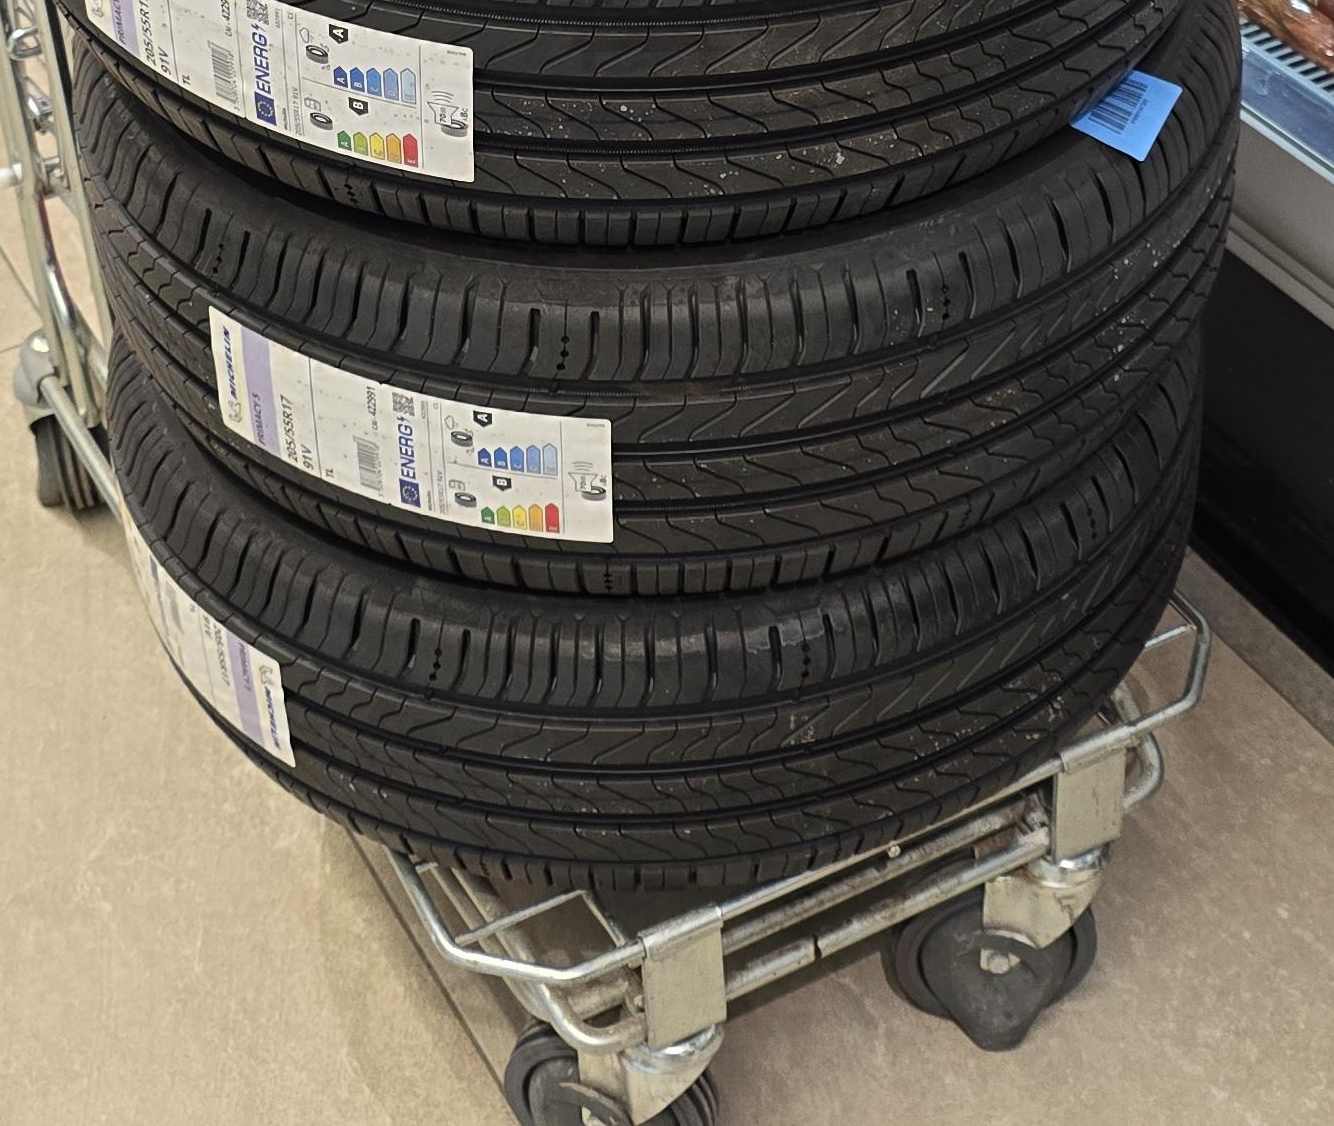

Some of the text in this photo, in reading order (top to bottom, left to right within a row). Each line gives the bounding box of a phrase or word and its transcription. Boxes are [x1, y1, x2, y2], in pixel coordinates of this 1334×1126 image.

[158, 47, 172, 75] 91V
[182, 74, 191, 86] TL
[252, 32, 271, 95] ENERG
[223, 326, 238, 400] MICHELIN
[366, 385, 377, 415] 422991
[280, 394, 298, 462] 205/55R17
[303, 444, 314, 470] 91V
[326, 468, 334, 478] TL
[398, 423, 417, 480] ENERG
[265, 686, 281, 751] MICHELIN
